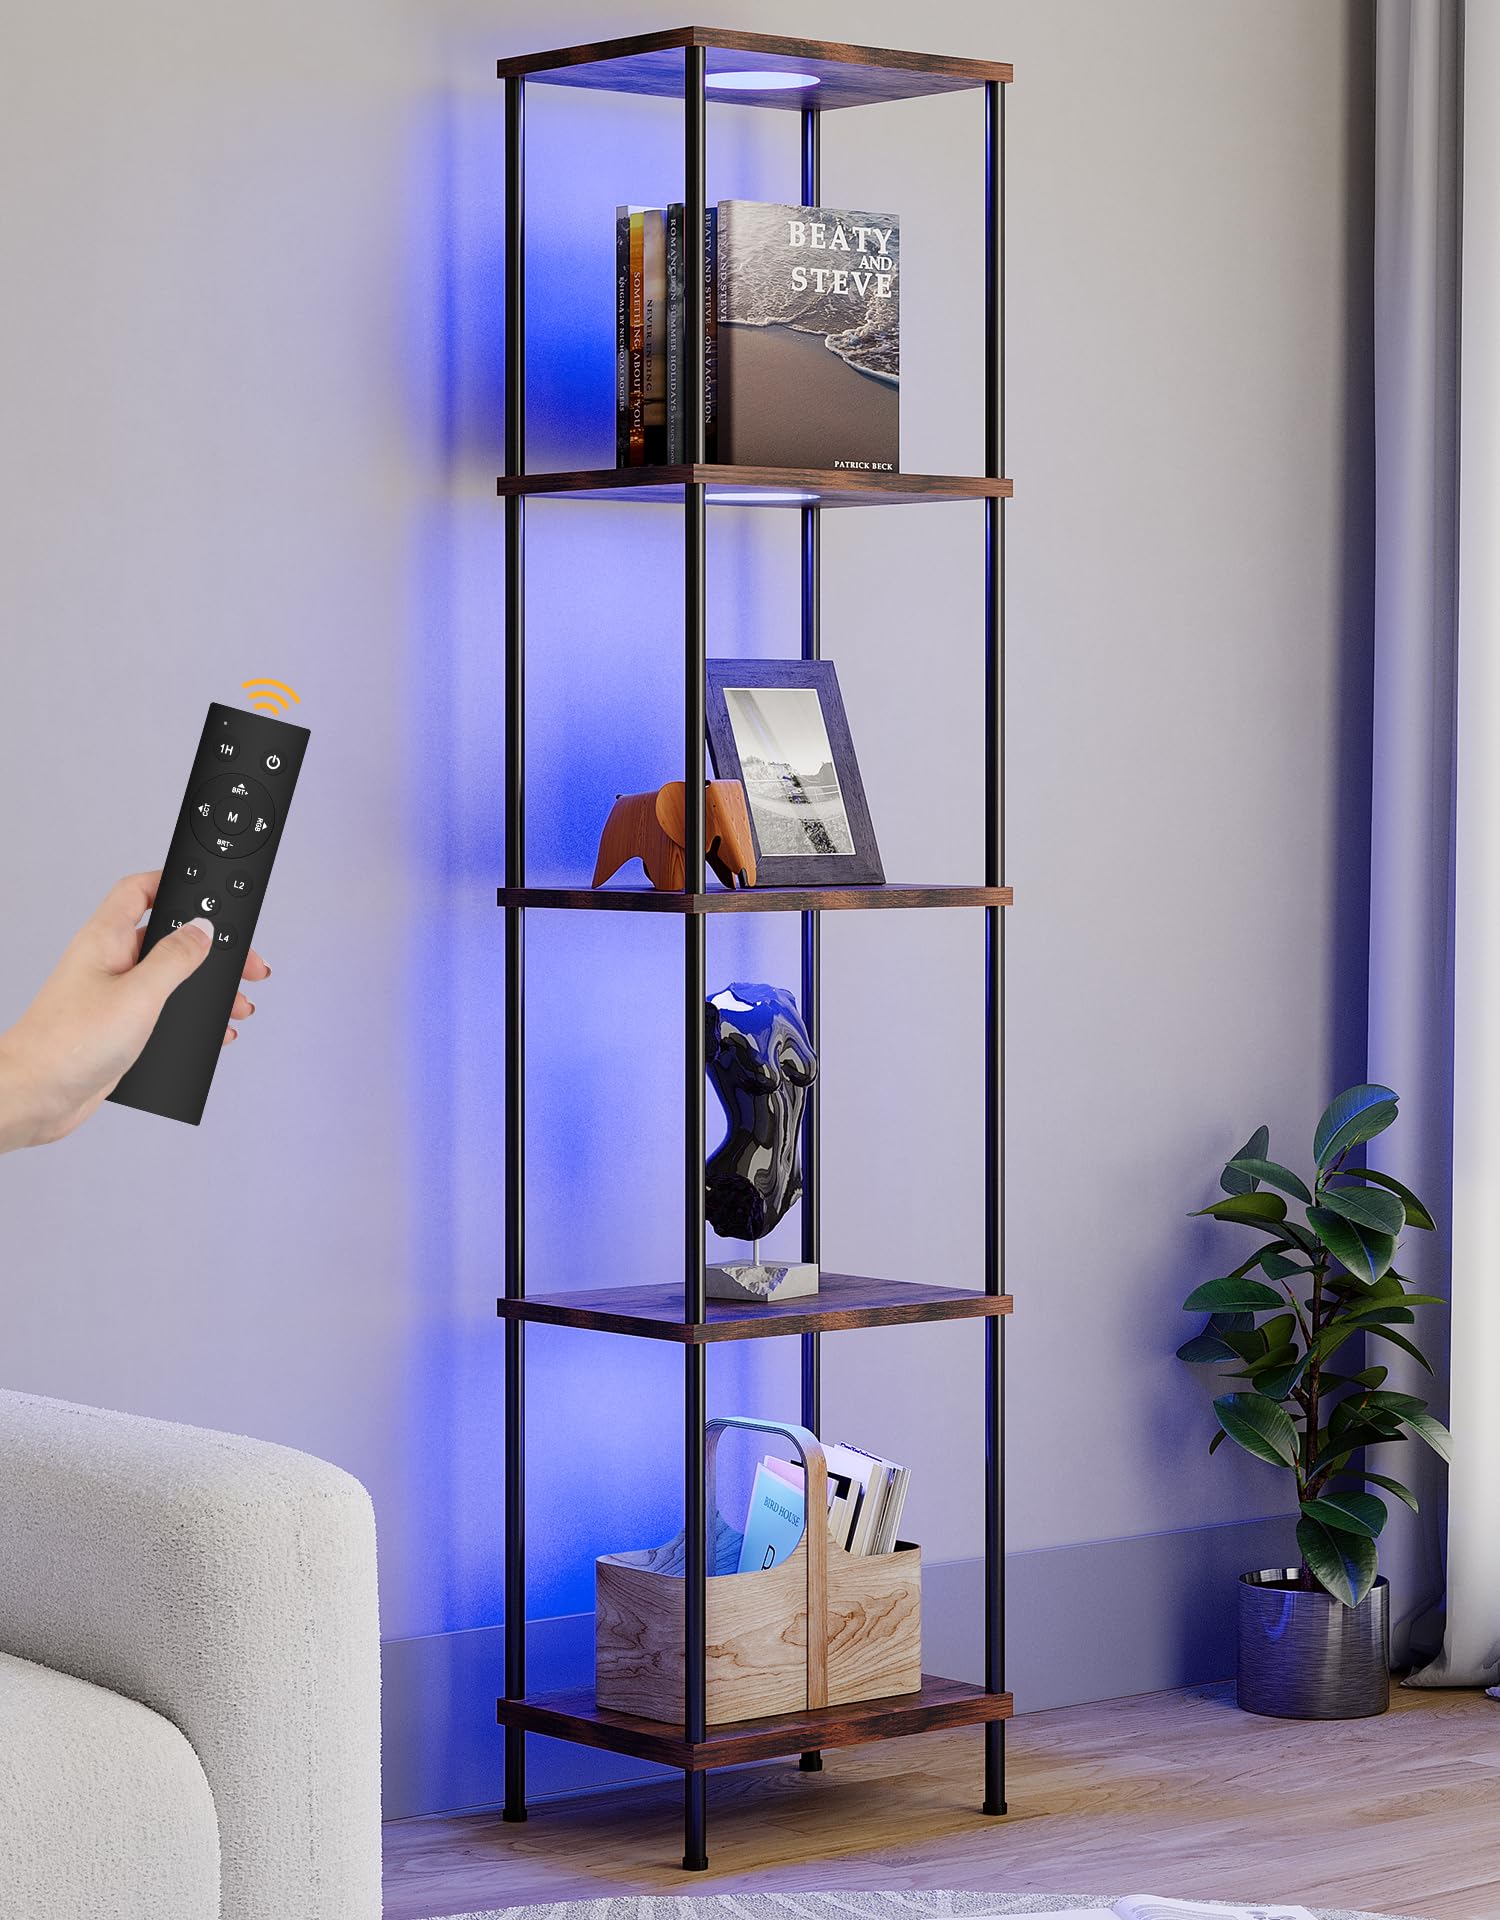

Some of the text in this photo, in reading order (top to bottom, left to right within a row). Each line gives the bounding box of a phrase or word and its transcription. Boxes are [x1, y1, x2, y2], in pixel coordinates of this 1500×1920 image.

[788, 220, 892, 254] BEATY
[720, 252, 728, 280] AND
[858, 255, 892, 271] AND
[791, 266, 892, 298] STEVE
[619, 276, 627, 313] ENIGMA
[670, 285, 677, 301] ON
[619, 315, 625, 325] BY
[633, 272, 641, 428] SOMETHING ABOUT YOU
[705, 336, 711, 354] ON
[834, 460, 893, 470] PATRICK BECK
[220, 743, 234, 756] 1H
[202, 803, 211, 817] CCT
[227, 811, 239, 823] M
[254, 817, 264, 832] RGB
[186, 867, 198, 877] L1
[233, 880, 245, 890] L2
[171, 919, 183, 929] L3
[218, 932, 230, 943] L4
[763, 1496, 801, 1528] BIRD HOUSE
